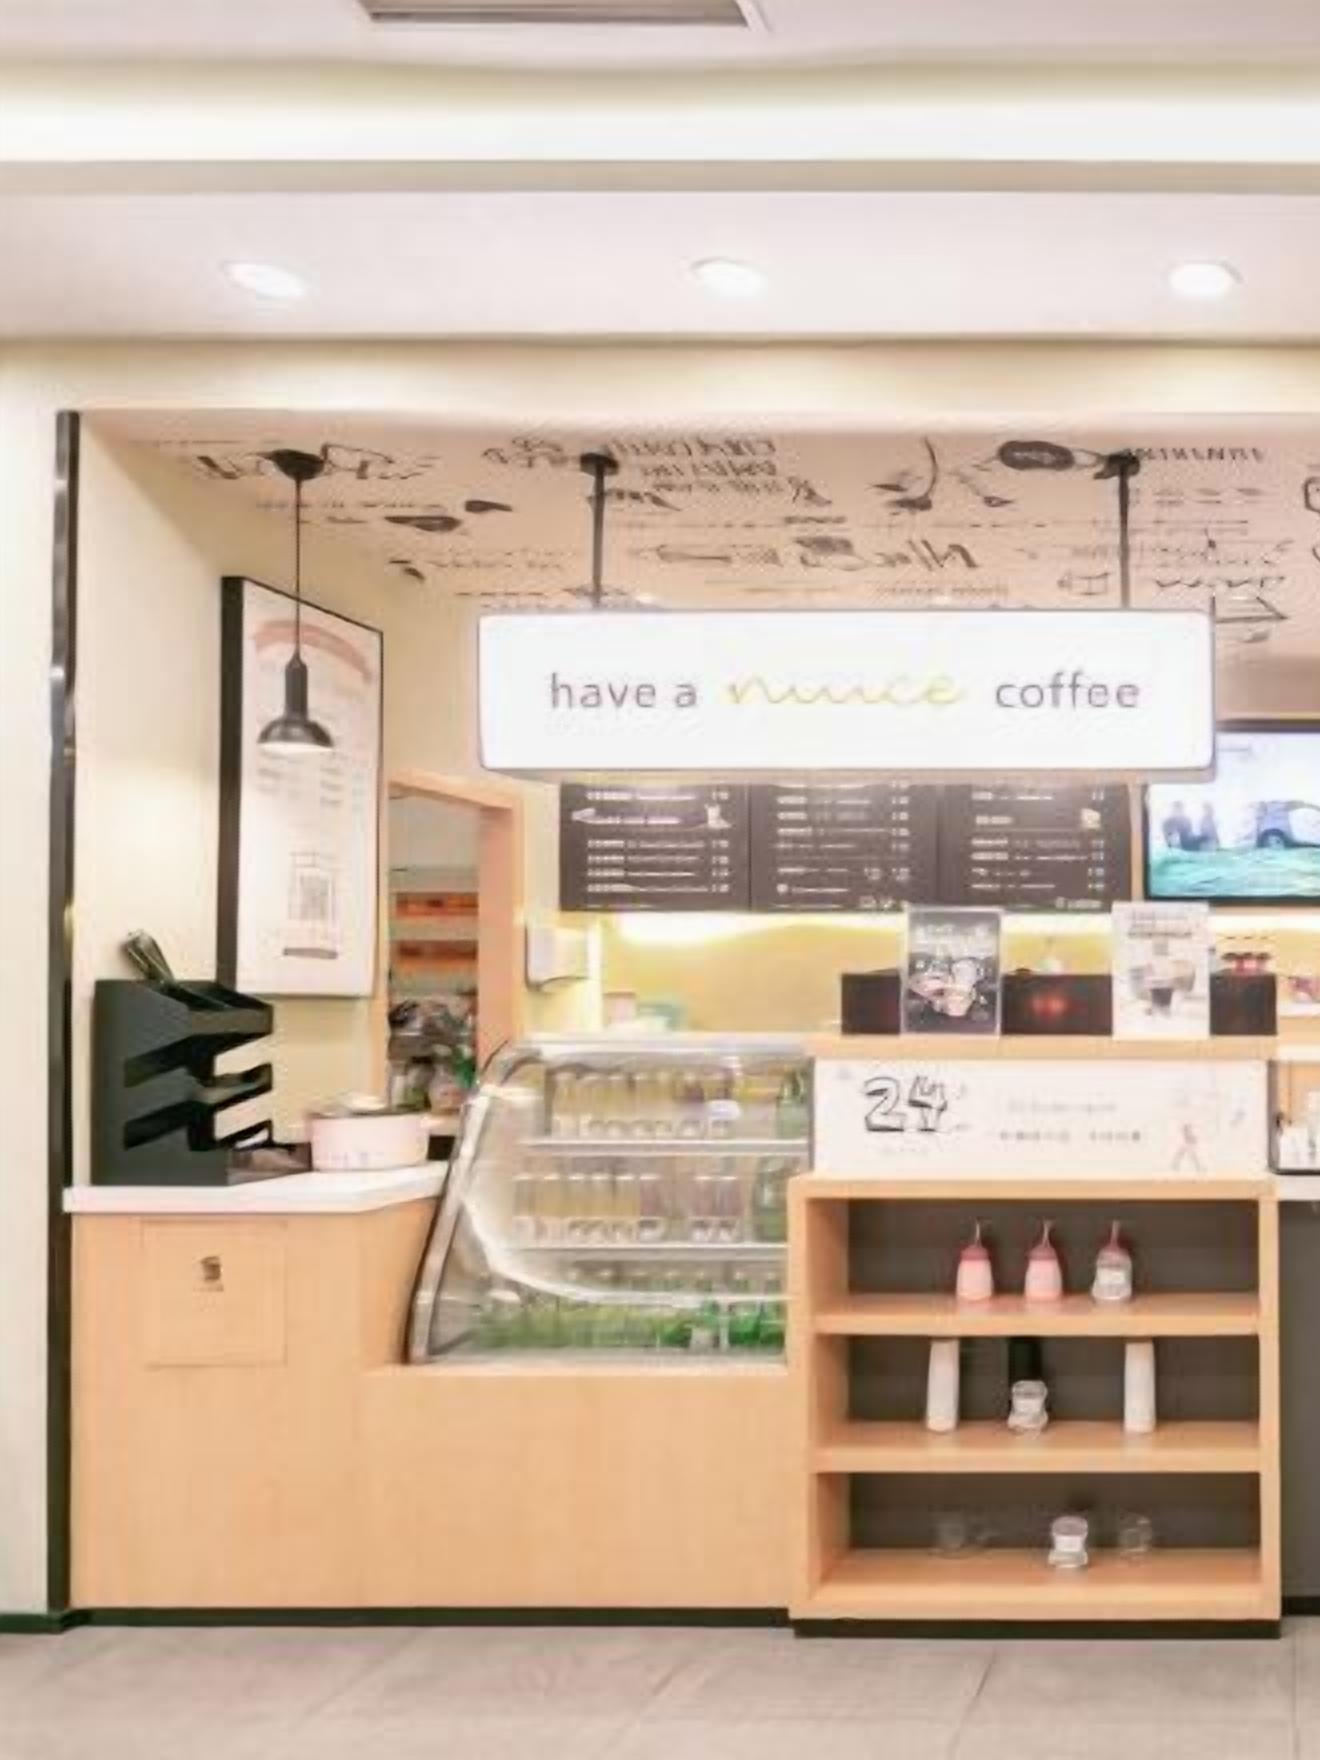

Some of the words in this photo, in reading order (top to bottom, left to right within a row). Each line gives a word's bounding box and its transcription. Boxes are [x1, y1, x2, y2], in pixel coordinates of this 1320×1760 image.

[550, 671, 656, 708] have
[674, 682, 697, 708] a
[994, 670, 1139, 708] coffee
[863, 1075, 948, 1133] 24
